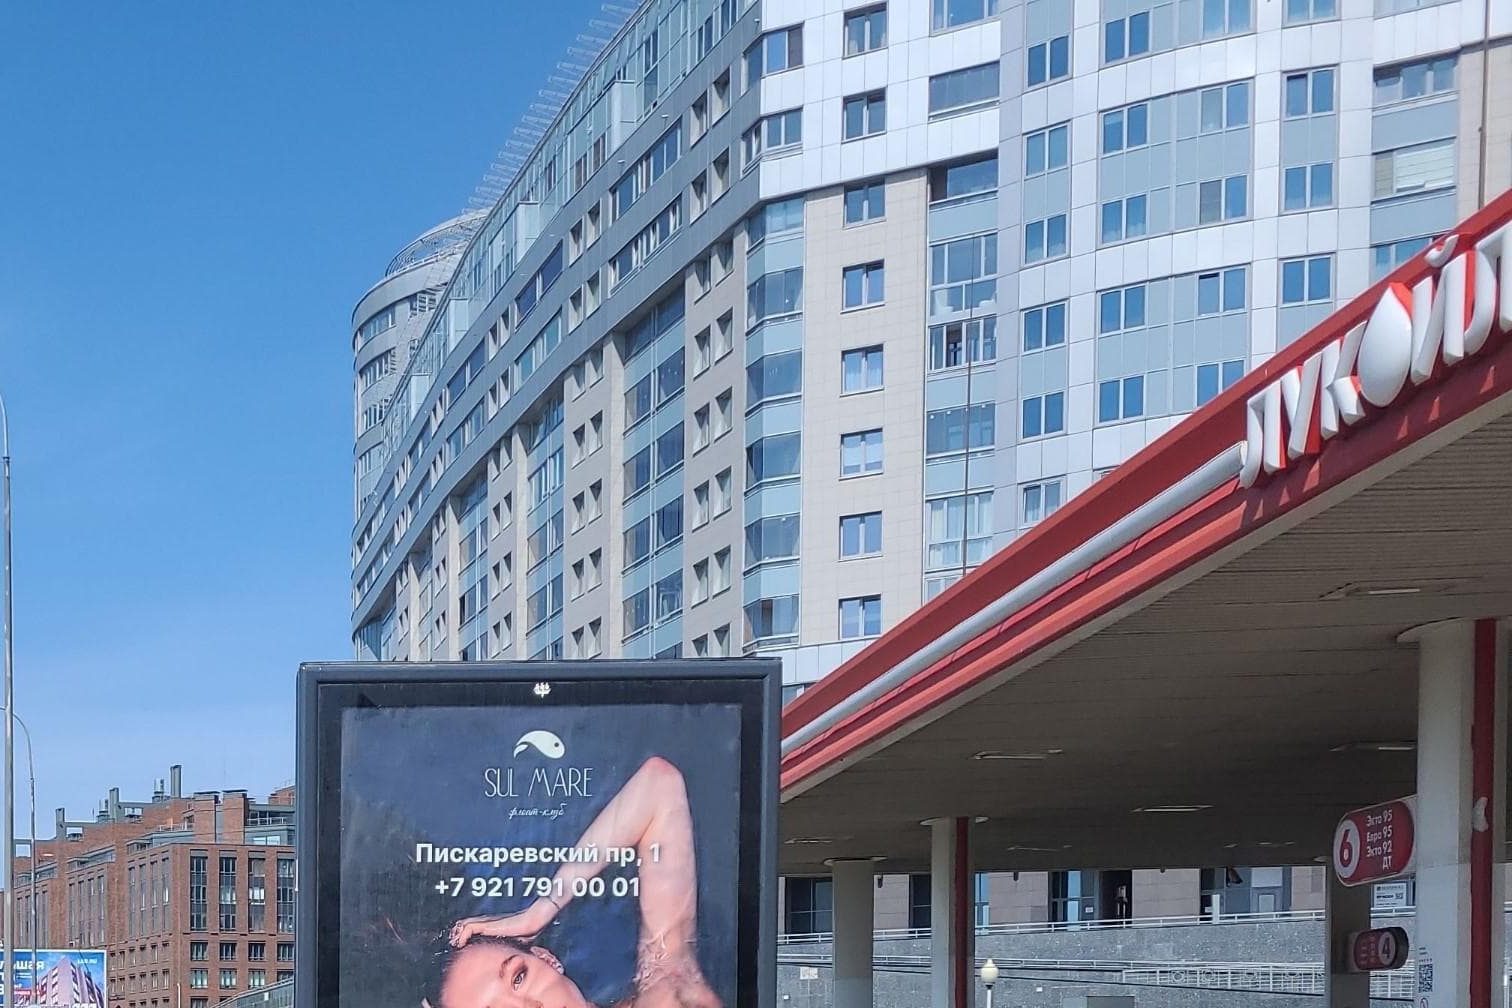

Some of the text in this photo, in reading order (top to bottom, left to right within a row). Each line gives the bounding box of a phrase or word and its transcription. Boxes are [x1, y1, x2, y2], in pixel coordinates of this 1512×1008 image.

[484, 767, 593, 797] SUL MARE
[508, 803, 568, 820] флоат-клуб
[1383, 809, 1393, 823] 95
[1383, 825, 1393, 838] 95
[415, 842, 661, 868] Пискаревский пр, 1
[1339, 828, 1353, 868] 6
[1383, 840, 1393, 854] 92
[1382, 856, 1392, 871] ДТ
[435, 877, 640, 897] +7 921 791 00 01
[1382, 936, 1392, 959] 4
